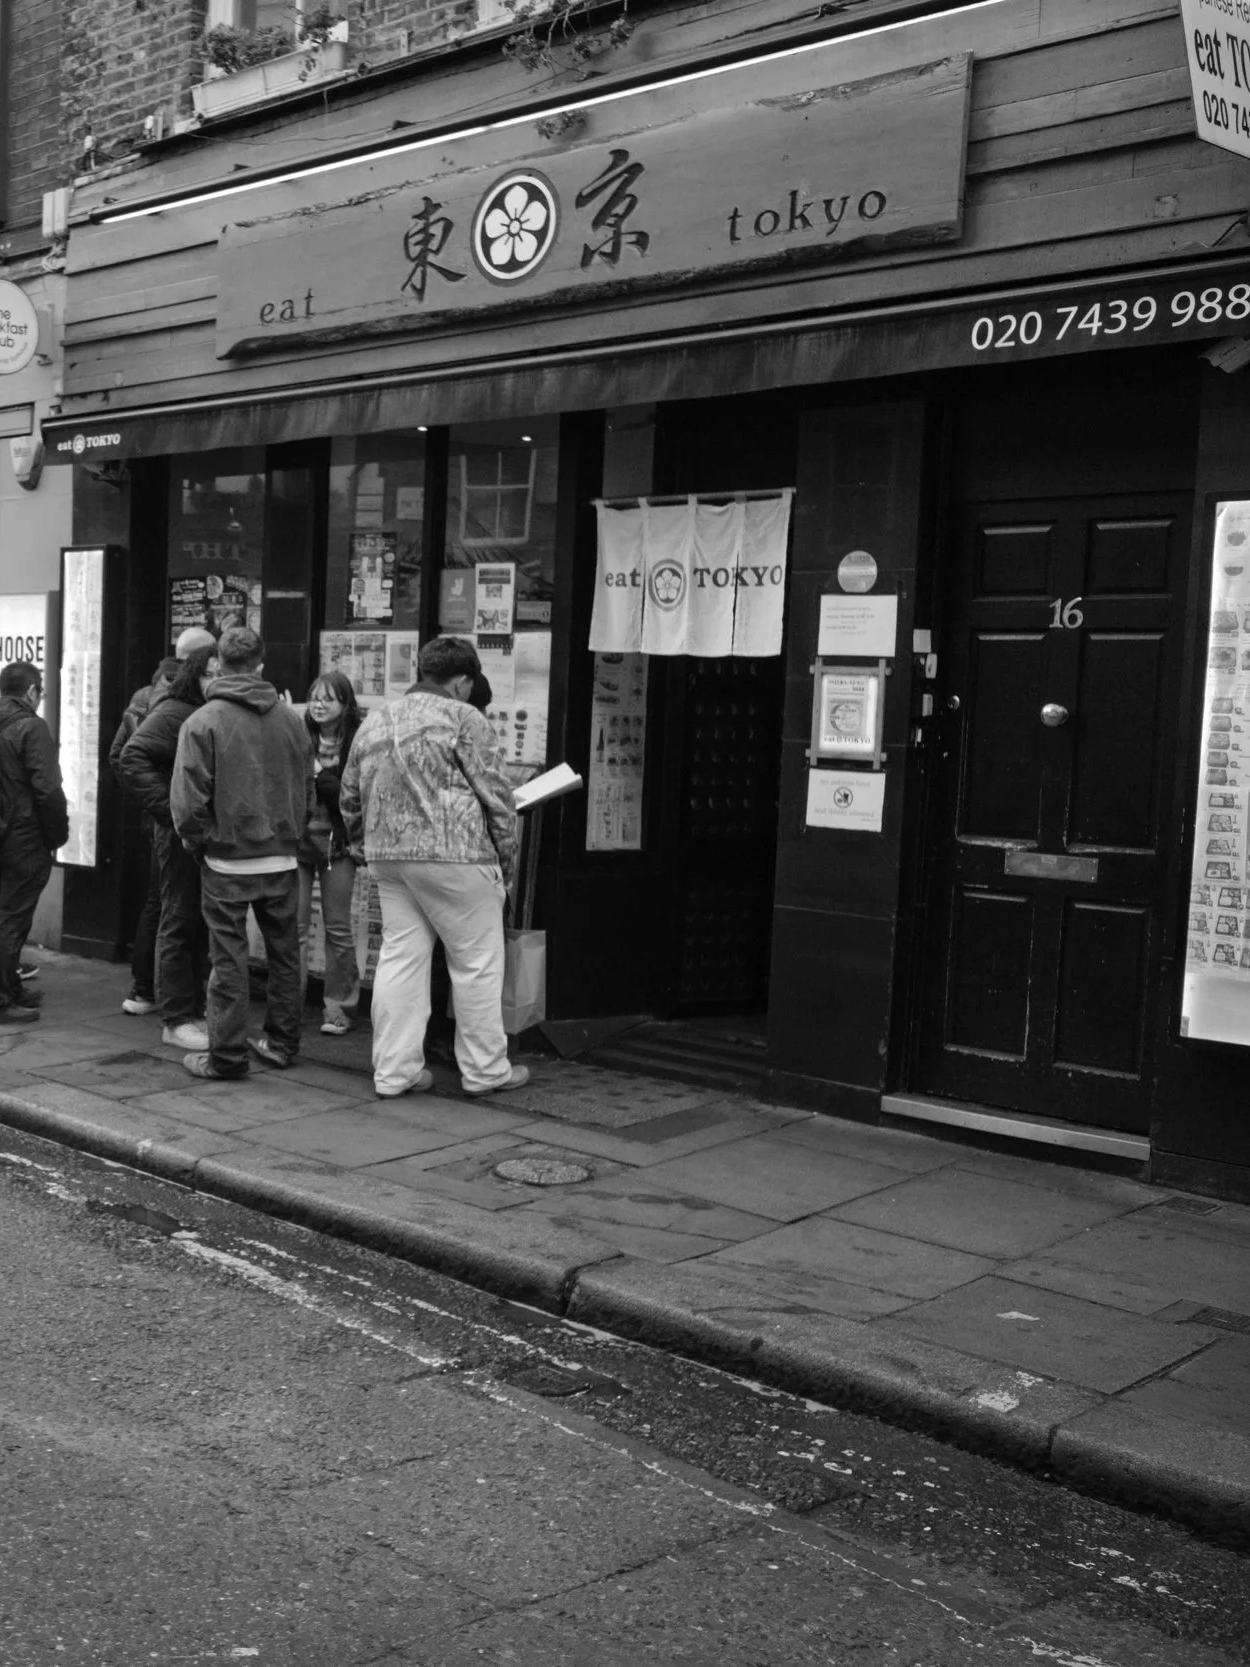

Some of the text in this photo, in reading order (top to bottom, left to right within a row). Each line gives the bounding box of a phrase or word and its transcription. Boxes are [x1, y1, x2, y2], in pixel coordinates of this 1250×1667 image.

[1194, 28, 1225, 80] eat
[1203, 90, 1250, 139] 020 74
[259, 288, 316, 324] eat
[727, 189, 887, 245] tokyo
[970, 311, 1043, 350] 020
[1055, 296, 1158, 341] 7439
[56, 433, 121, 452] eat TOKYO
[605, 565, 783, 588] eat TOKYO
[1049, 596, 1084, 629] 16
